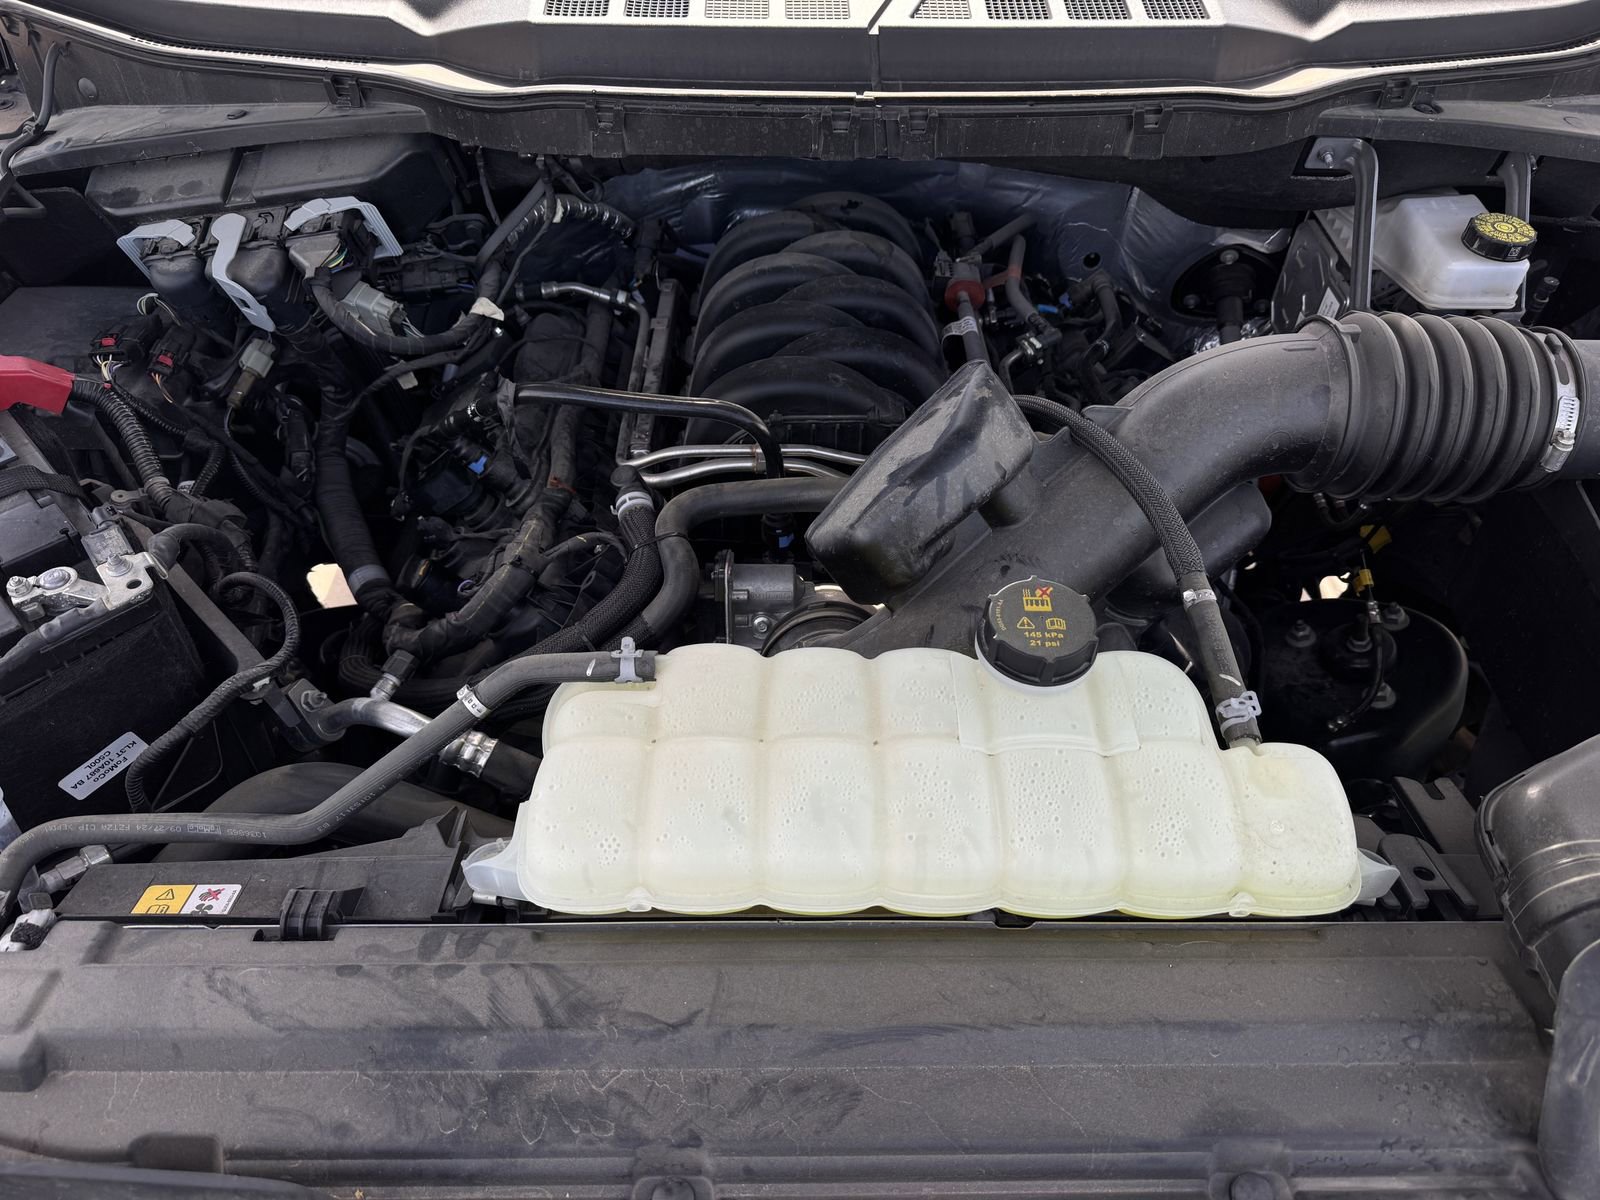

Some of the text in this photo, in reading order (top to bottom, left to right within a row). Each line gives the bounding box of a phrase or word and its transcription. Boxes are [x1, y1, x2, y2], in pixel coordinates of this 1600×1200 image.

[1045, 631, 1064, 639] kPa
[1045, 640, 1060, 648] psi
[115, 740, 137, 758] KL3T
[83, 750, 111, 770] C500L
[93, 756, 128, 783] FoMoCo
[70, 779, 85, 790] BA
